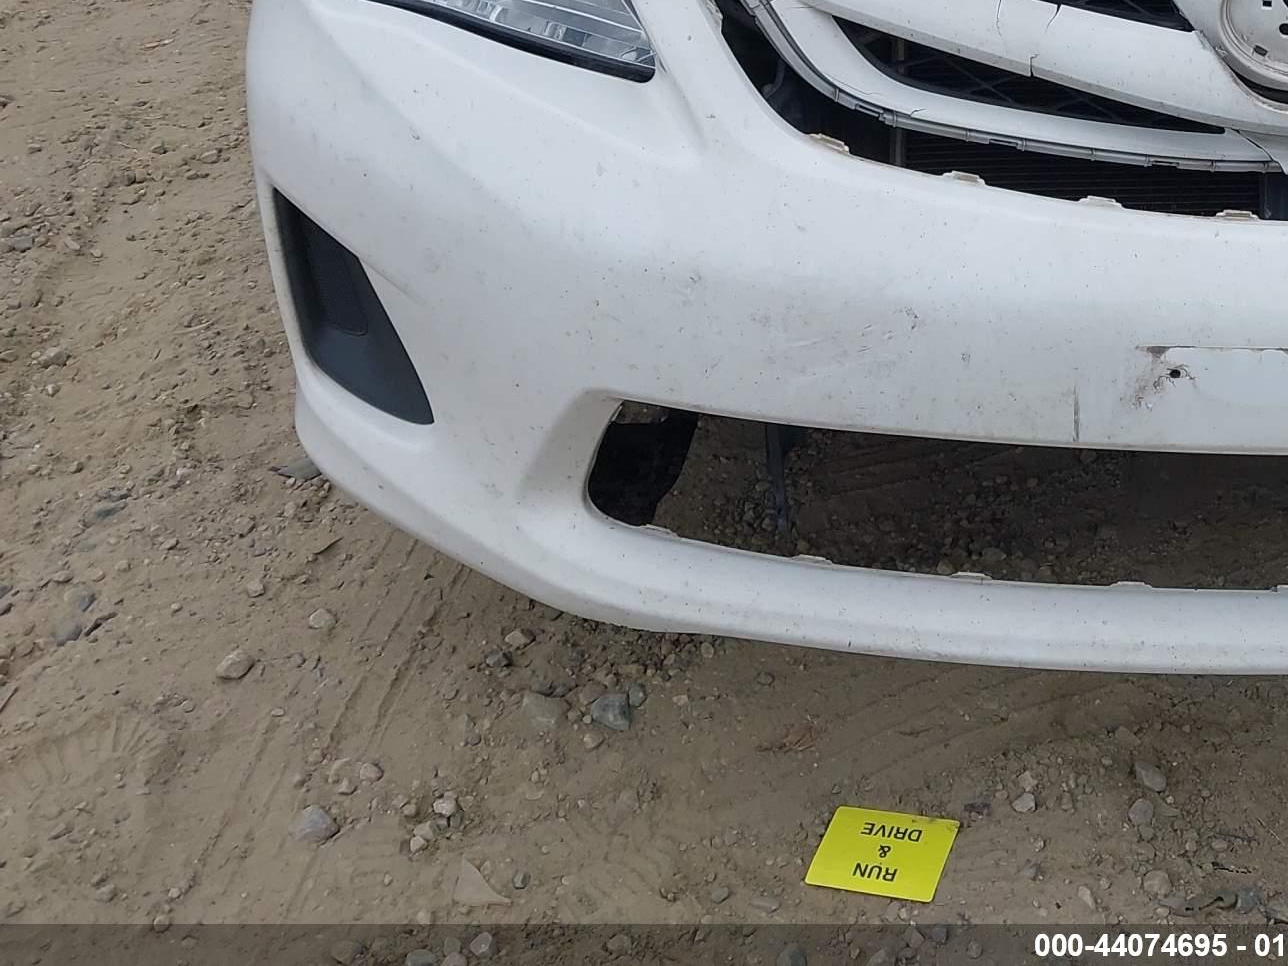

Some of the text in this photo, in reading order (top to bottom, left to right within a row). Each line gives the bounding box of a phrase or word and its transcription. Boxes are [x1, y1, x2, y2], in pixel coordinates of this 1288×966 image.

[860, 822, 923, 842] DRIVE
[877, 844, 892, 858] &
[852, 862, 898, 882] RUN
